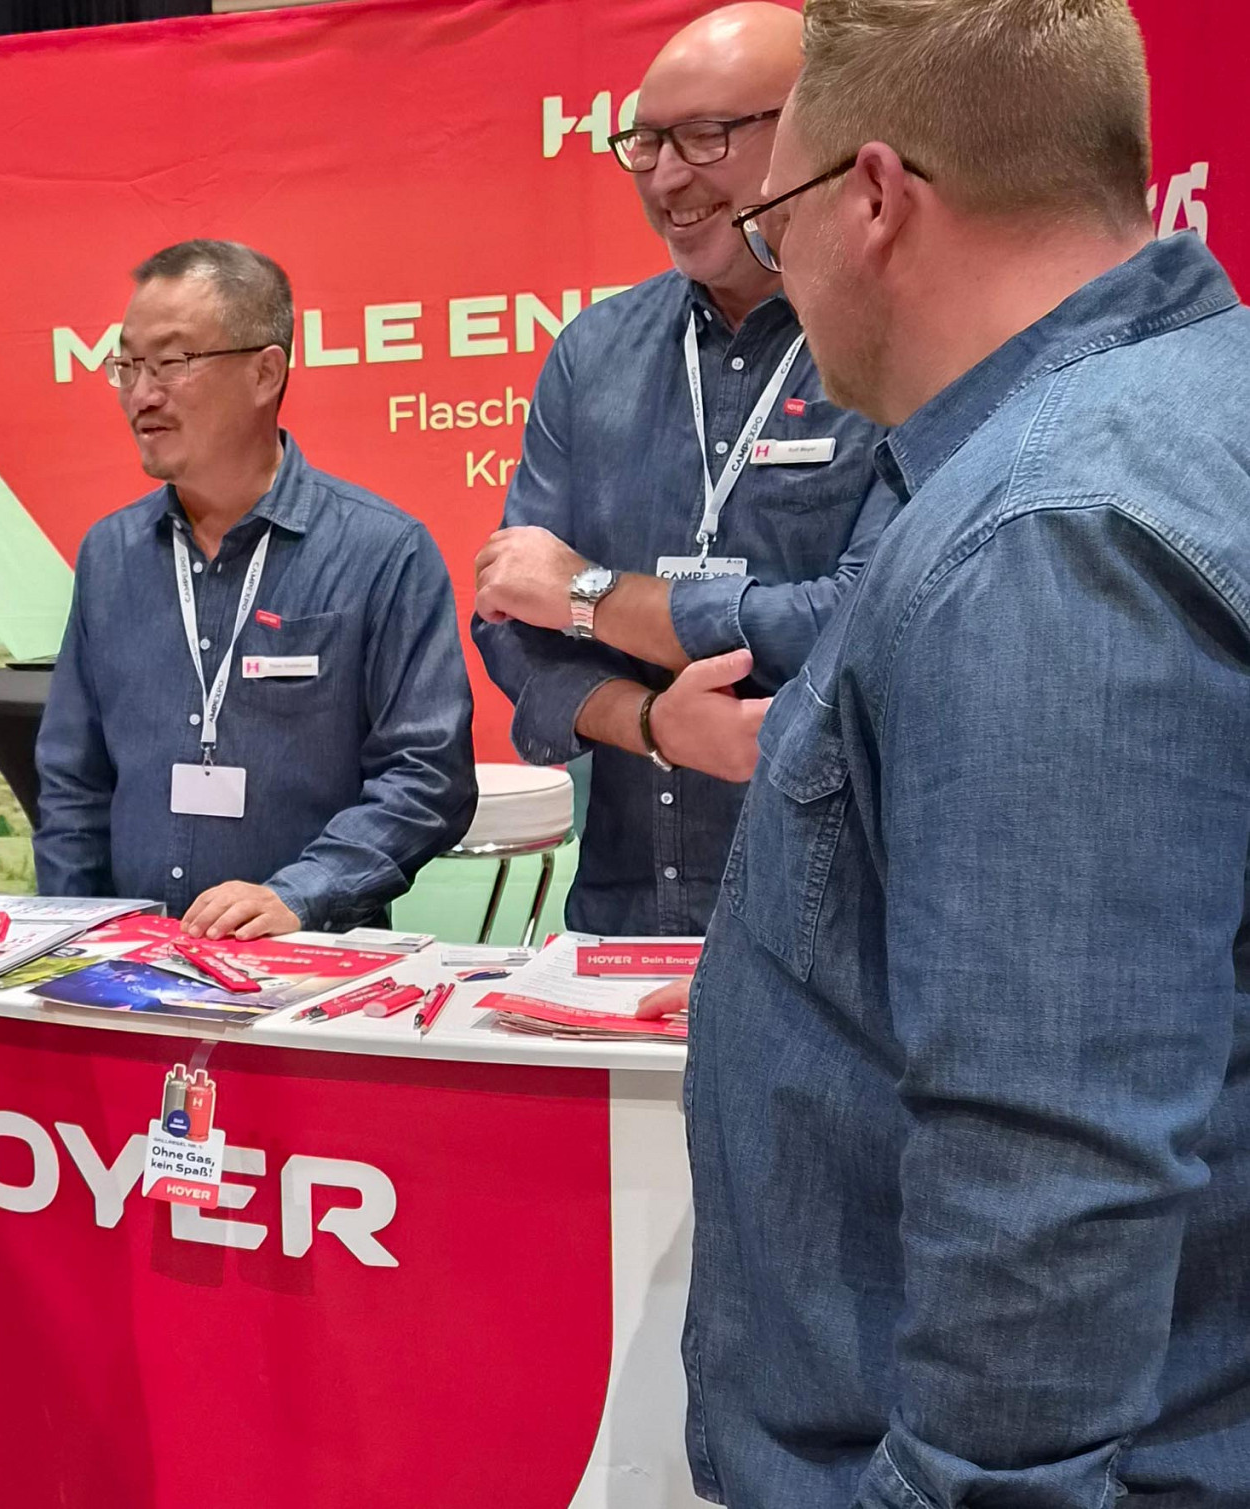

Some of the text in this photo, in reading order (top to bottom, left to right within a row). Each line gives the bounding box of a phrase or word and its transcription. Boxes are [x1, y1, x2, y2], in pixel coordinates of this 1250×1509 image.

[1146, 161, 1209, 245] AS
[449, 285, 635, 358] EN
[388, 386, 530, 433] Flasch
[731, 416, 763, 472] CAMPEXPO
[466, 449, 522, 488] Kr
[586, 955, 632, 965] HOYER
[151, 1158, 213, 1178] kein Spaß!
[152, 1146, 215, 1168] Ohne Gas,
[166, 1183, 211, 1201] HOYER
